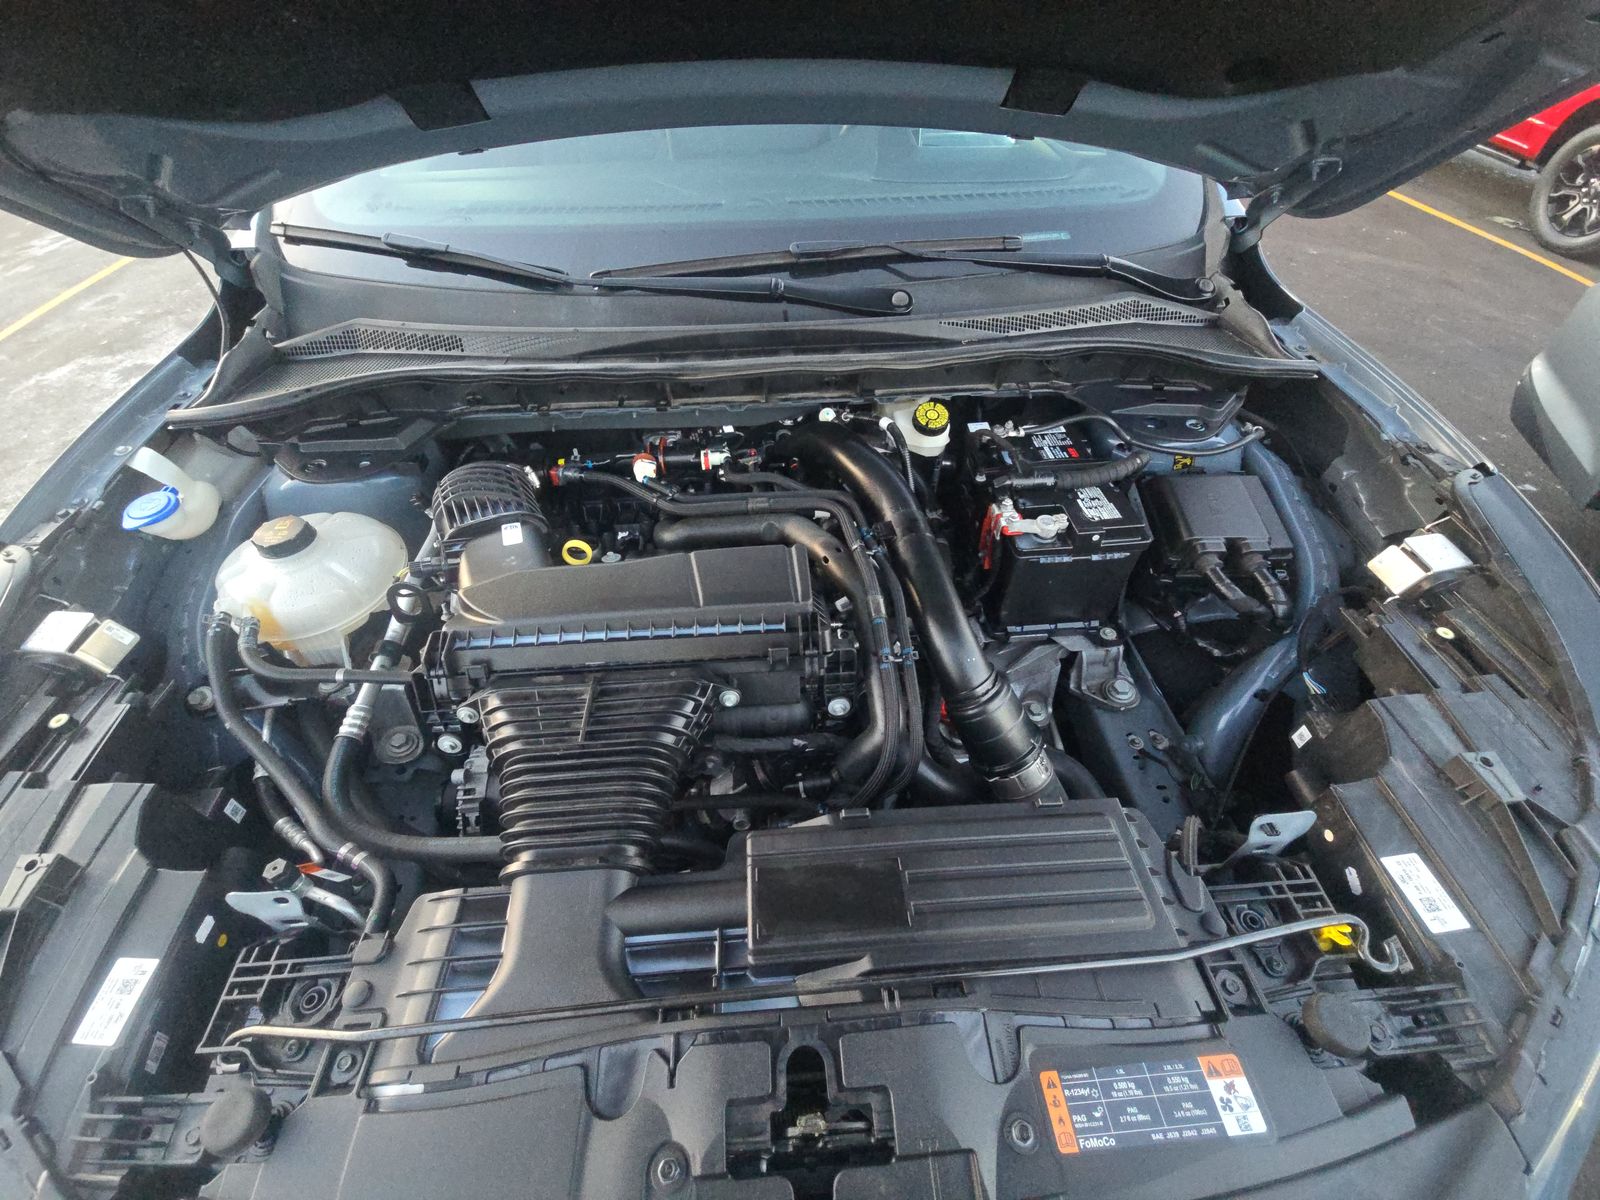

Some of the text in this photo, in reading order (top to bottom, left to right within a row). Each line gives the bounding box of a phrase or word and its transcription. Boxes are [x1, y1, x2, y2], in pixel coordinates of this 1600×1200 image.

[1181, 1075, 1189, 1084] kg
[1127, 1081, 1136, 1090] kg
[1064, 1087, 1090, 1097] R-1234yf
[1072, 1114, 1087, 1122] PAG
[1079, 1136, 1115, 1148] FoMoCo
